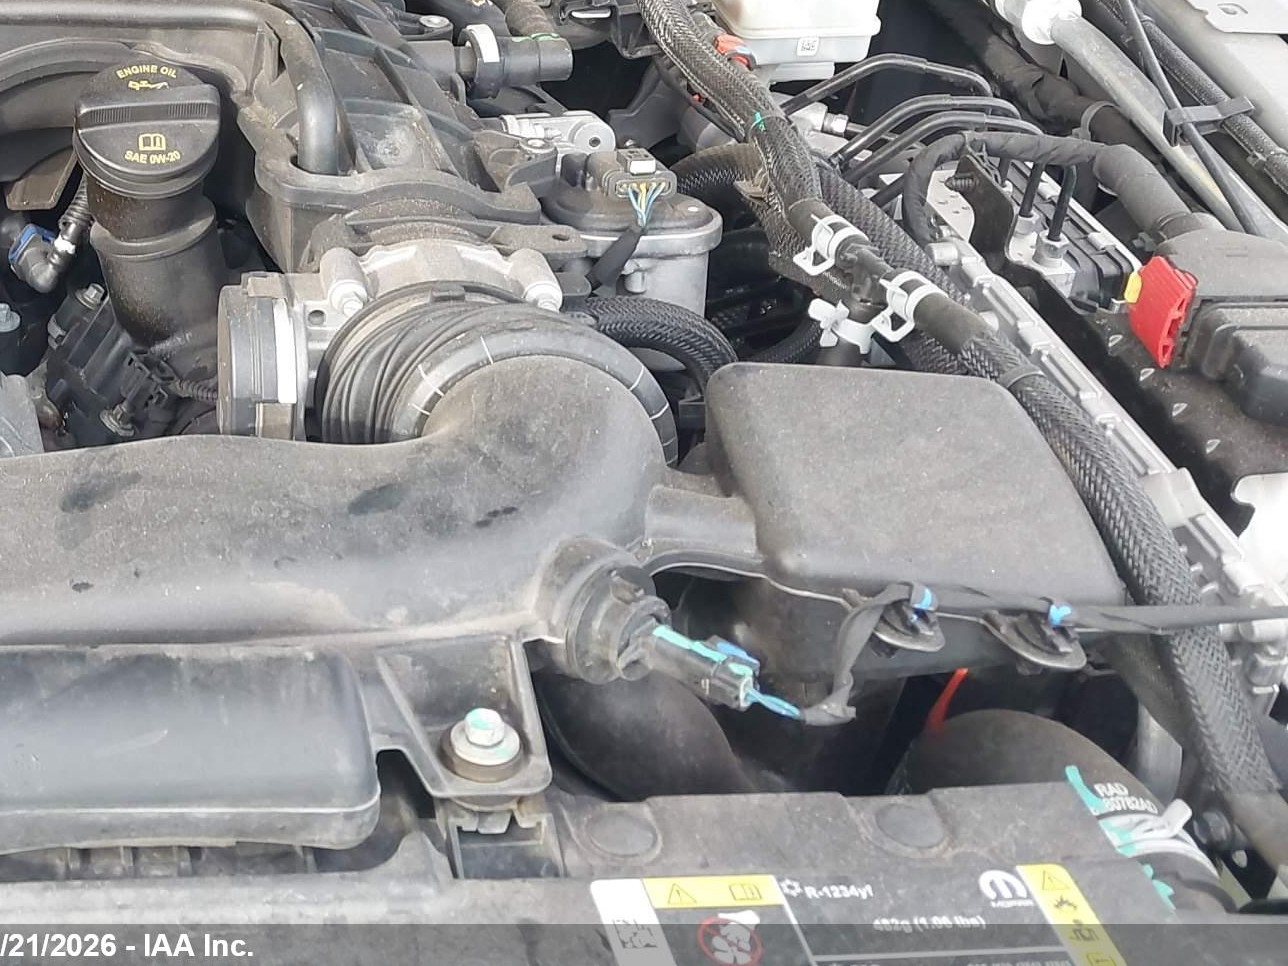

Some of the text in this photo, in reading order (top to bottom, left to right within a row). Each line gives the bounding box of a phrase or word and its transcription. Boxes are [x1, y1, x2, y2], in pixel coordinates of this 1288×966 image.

[116, 65, 177, 79] ENGINE OIL
[124, 150, 181, 164] SAE 0W-20
[1094, 782, 1128, 797] RAD
[804, 884, 874, 900] R-1234yf
